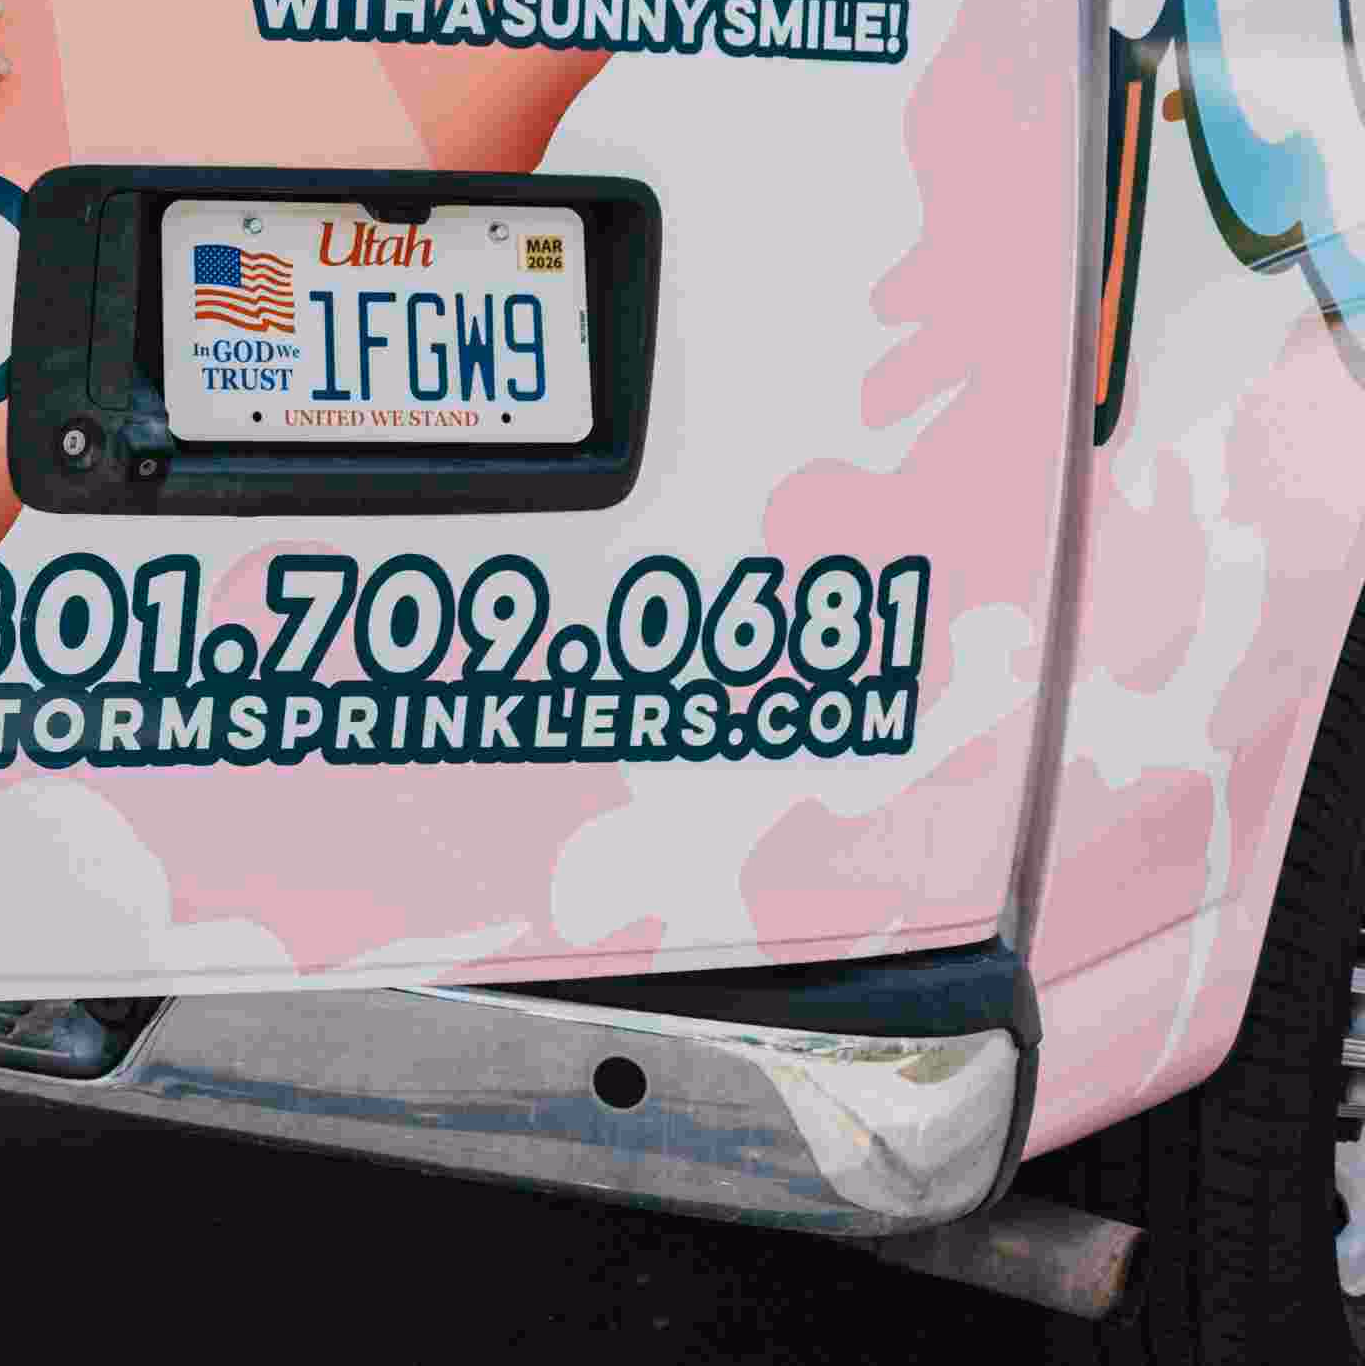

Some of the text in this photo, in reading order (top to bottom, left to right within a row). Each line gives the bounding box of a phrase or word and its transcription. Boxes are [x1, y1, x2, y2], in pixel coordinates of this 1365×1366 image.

[317, 220, 434, 268] Utah
[525, 239, 564, 254] MAR
[527, 256, 563, 270] 2026
[192, 339, 301, 364] In GOD We
[308, 290, 547, 402] 1FGW9
[201, 366, 294, 391] TRUST
[284, 408, 480, 428] UNITED WE STAND
